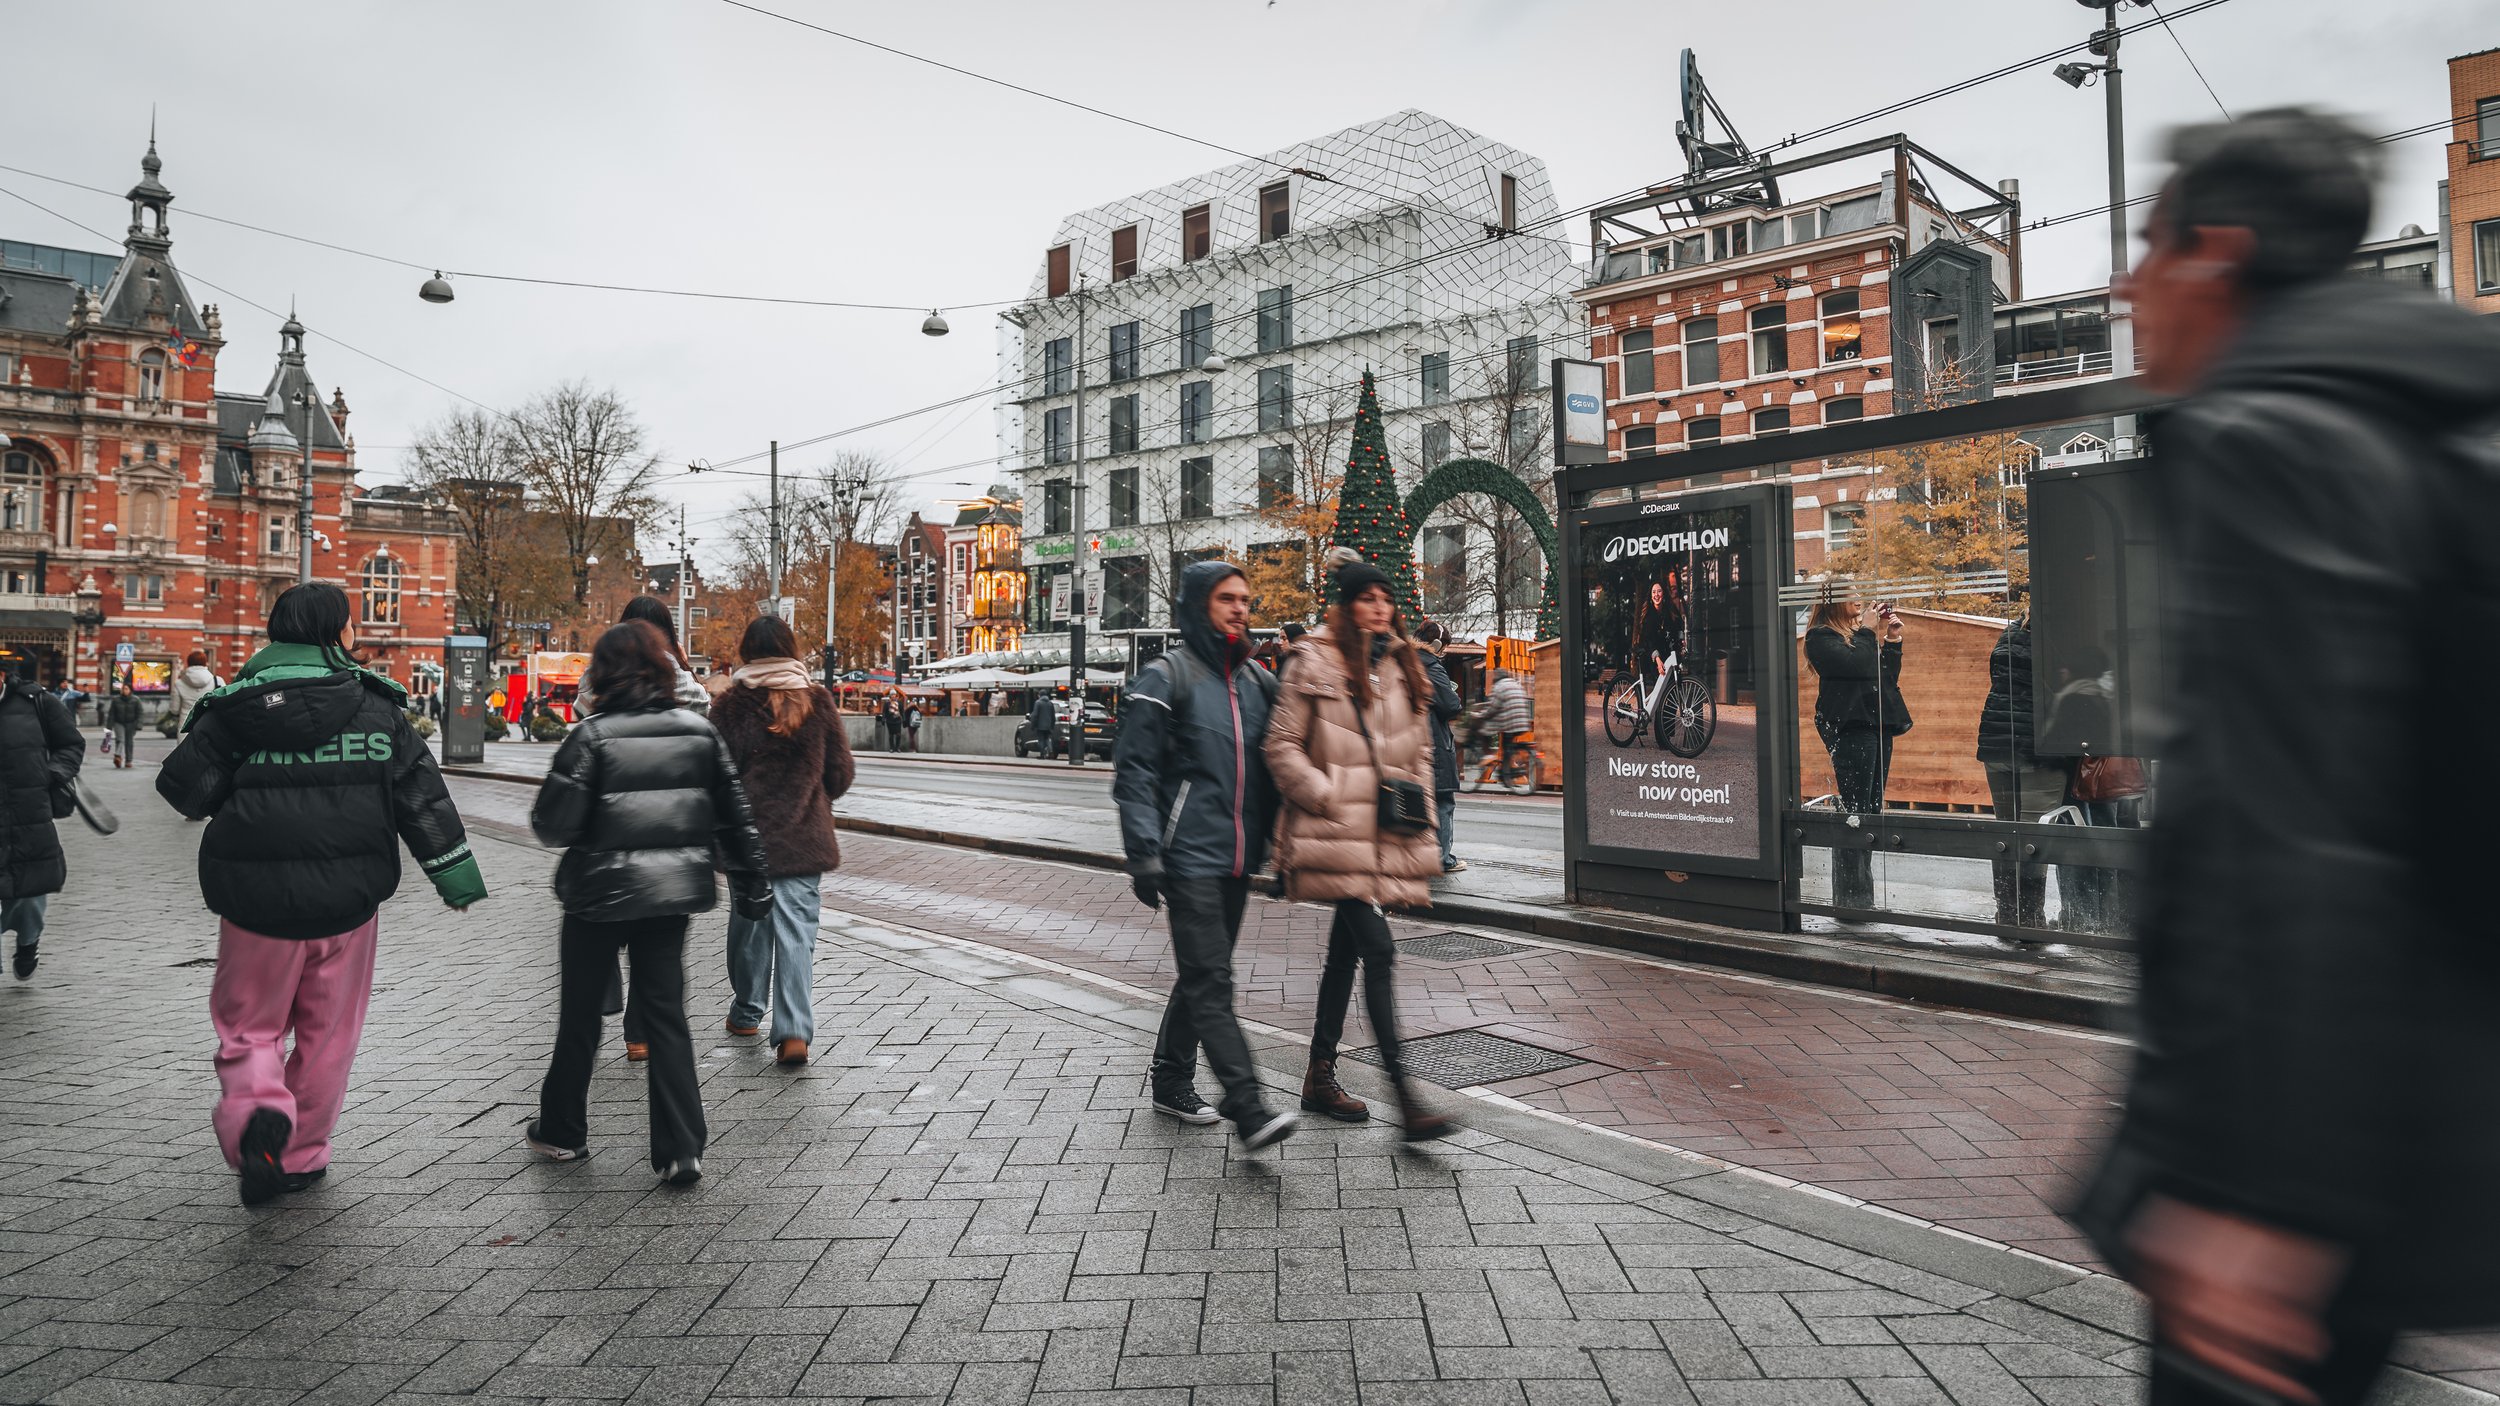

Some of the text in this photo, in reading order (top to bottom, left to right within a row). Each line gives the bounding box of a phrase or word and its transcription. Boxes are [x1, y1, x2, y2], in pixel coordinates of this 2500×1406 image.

[1640, 502, 1680, 515] JCDecaux
[1627, 527, 1729, 557] DECATHLON
[1608, 757, 1701, 784] New store,
[1639, 784, 1730, 807] now open!
[1616, 809, 1630, 817] Visit
[1644, 811, 1679, 821] Amsterdam
[1678, 813, 1725, 824] Bilderdijkstraat
[1725, 816, 1734, 824] 49
